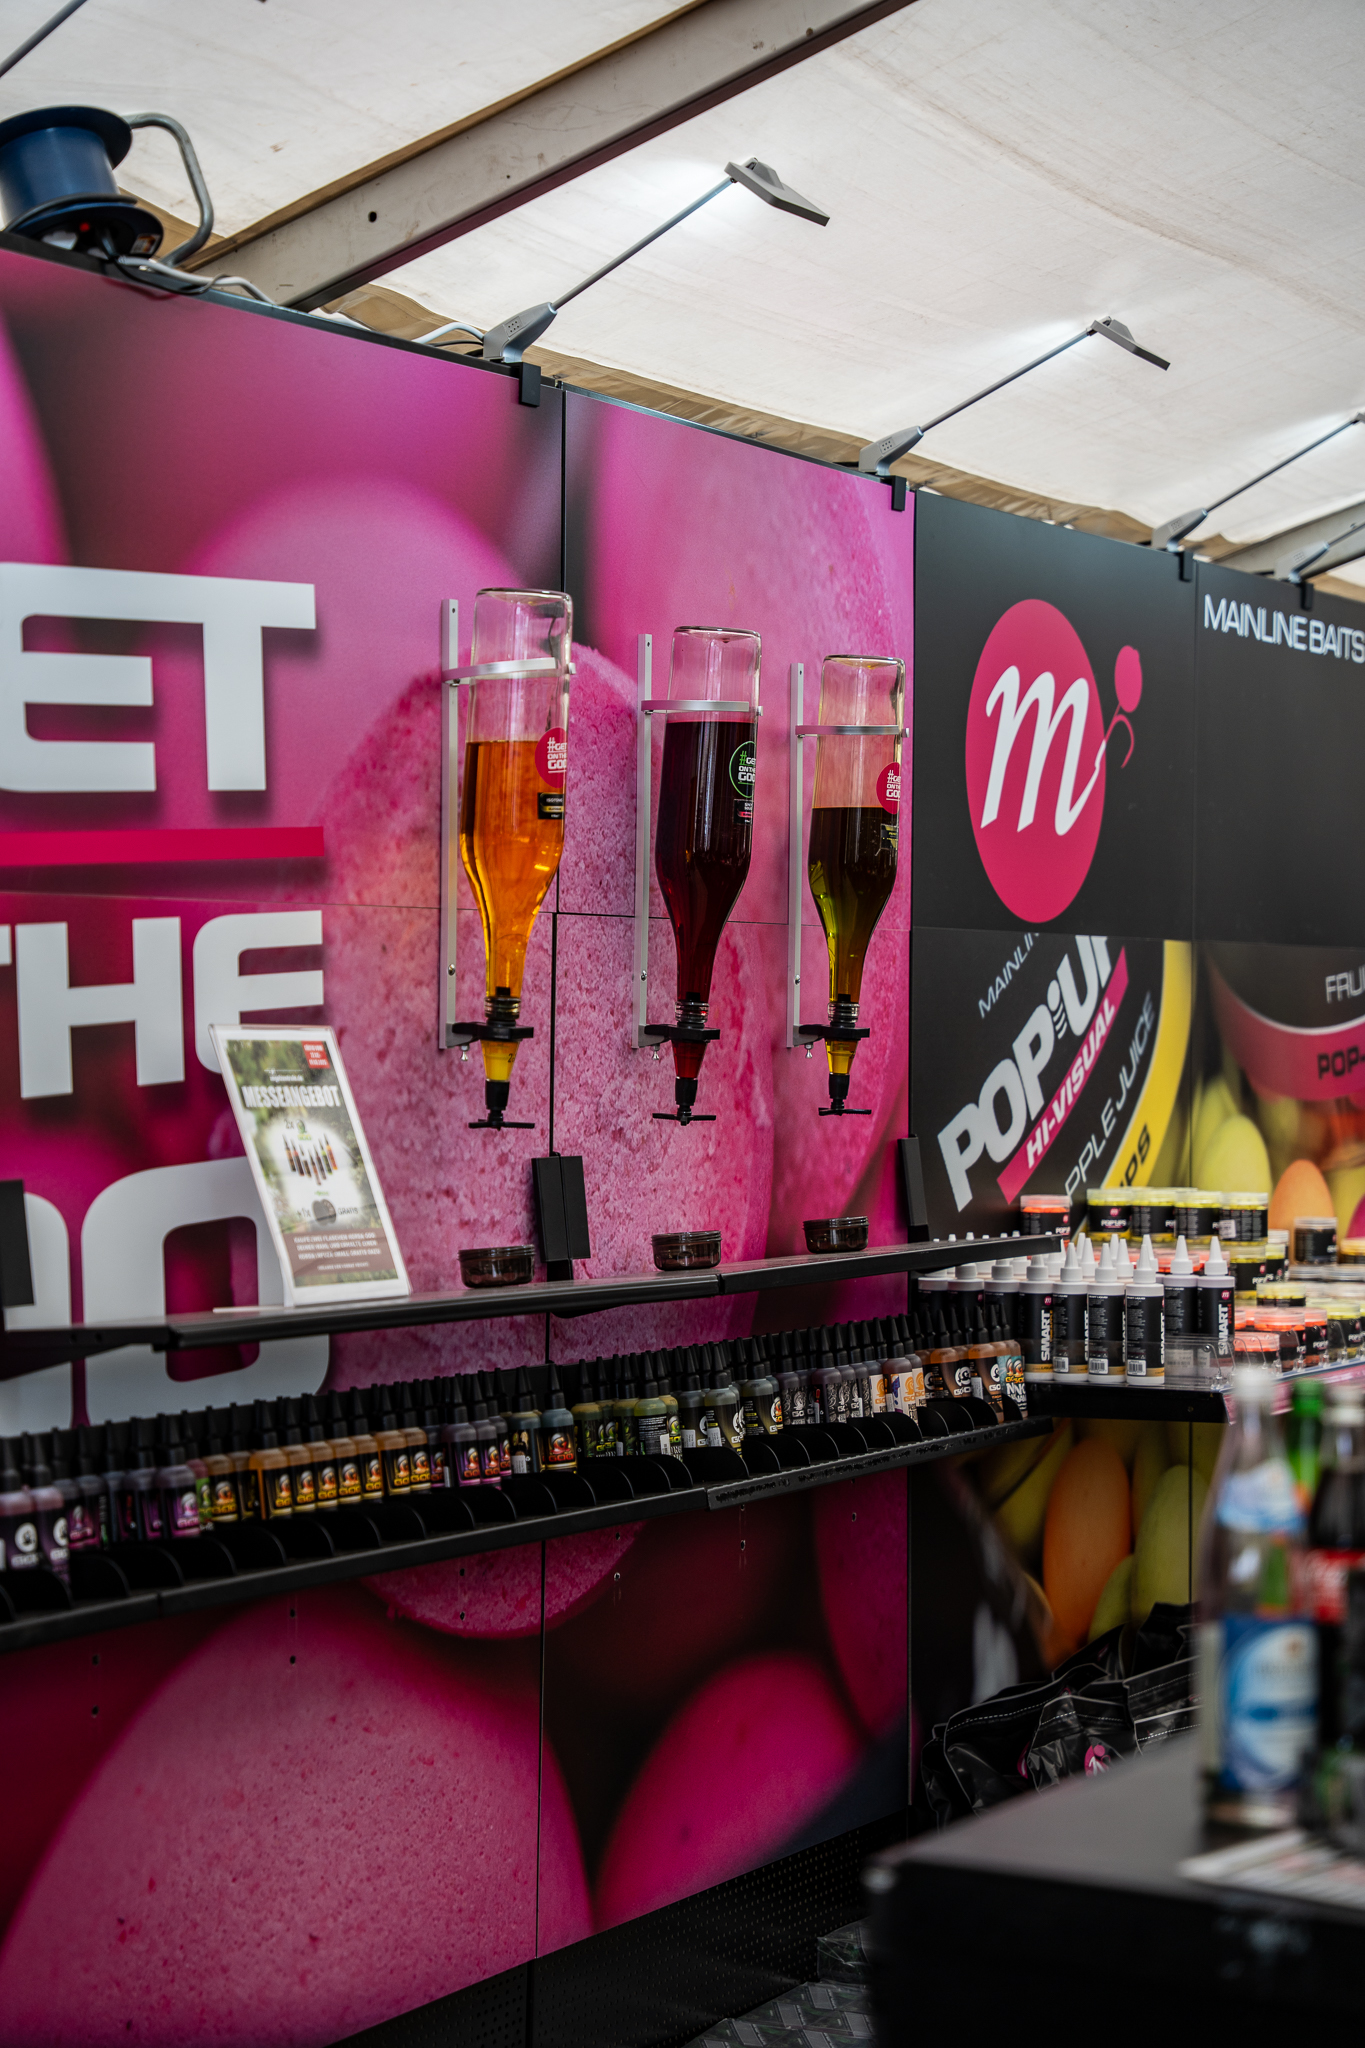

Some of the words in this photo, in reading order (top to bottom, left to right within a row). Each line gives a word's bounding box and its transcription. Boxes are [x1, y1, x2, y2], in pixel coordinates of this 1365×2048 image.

[1203, 593, 1308, 651] MAINLINE
[1309, 619, 1365, 664] BAITS
[0, 909, 325, 1100] HE
[978, 932, 1040, 1019] MAINLI
[1116, 990, 1155, 1112] JUICE
[241, 1085, 340, 1108] MESSEANGEBOT
[1027, 997, 1115, 1169] HI-VISUAL
[338, 1207, 358, 1215] GRATIS
[1041, 1310, 1050, 1362] SMART
[1218, 1304, 1228, 1355] SMART
[548, 1453, 574, 1462] GOO
